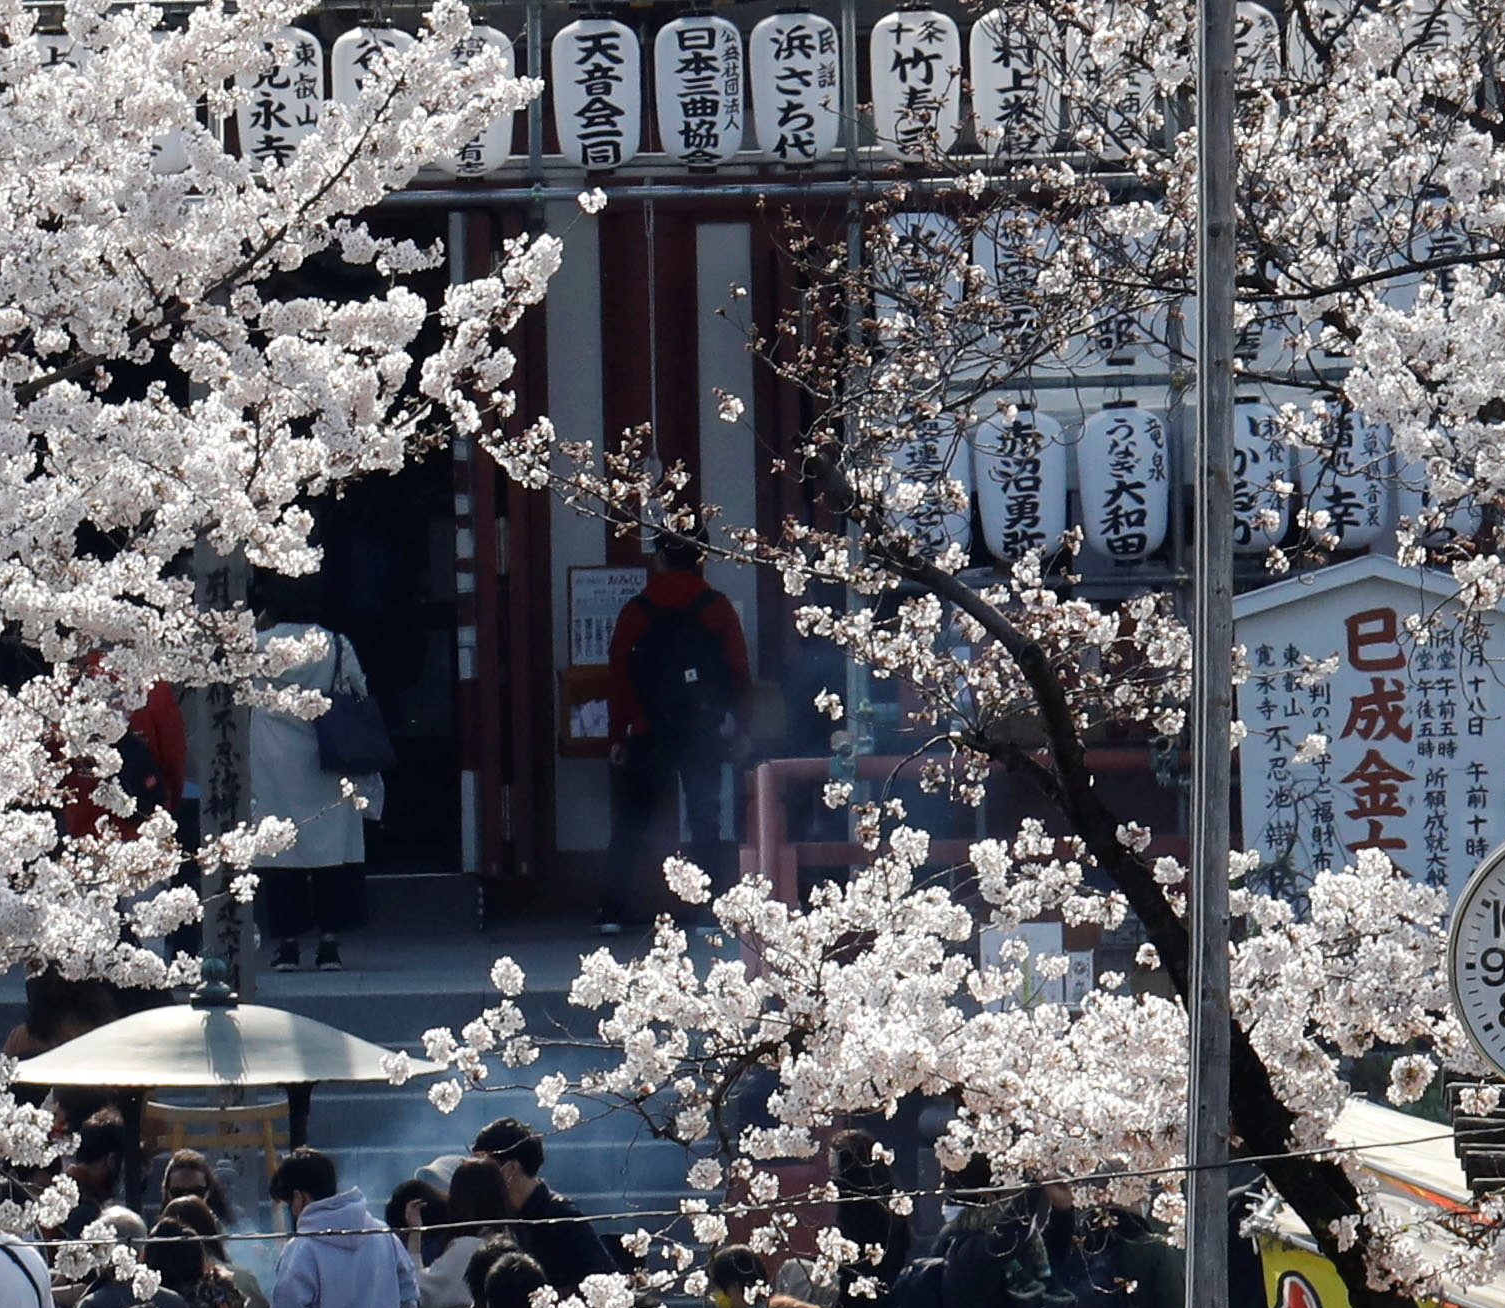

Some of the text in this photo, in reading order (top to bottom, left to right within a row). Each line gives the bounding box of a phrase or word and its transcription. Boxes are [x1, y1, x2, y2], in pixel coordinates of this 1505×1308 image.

[294, 40, 319, 126] 東叡山
[574, 31, 625, 165] 天音会一同
[675, 27, 723, 163] 日本三曲協会
[721, 30, 740, 132] 公益社団法人
[770, 25, 817, 160] 浜さち代
[817, 28, 836, 88] 民謡
[1100, 418, 1149, 557] うなぎ大和田
[1465, 762, 1489, 864] 午前十時
